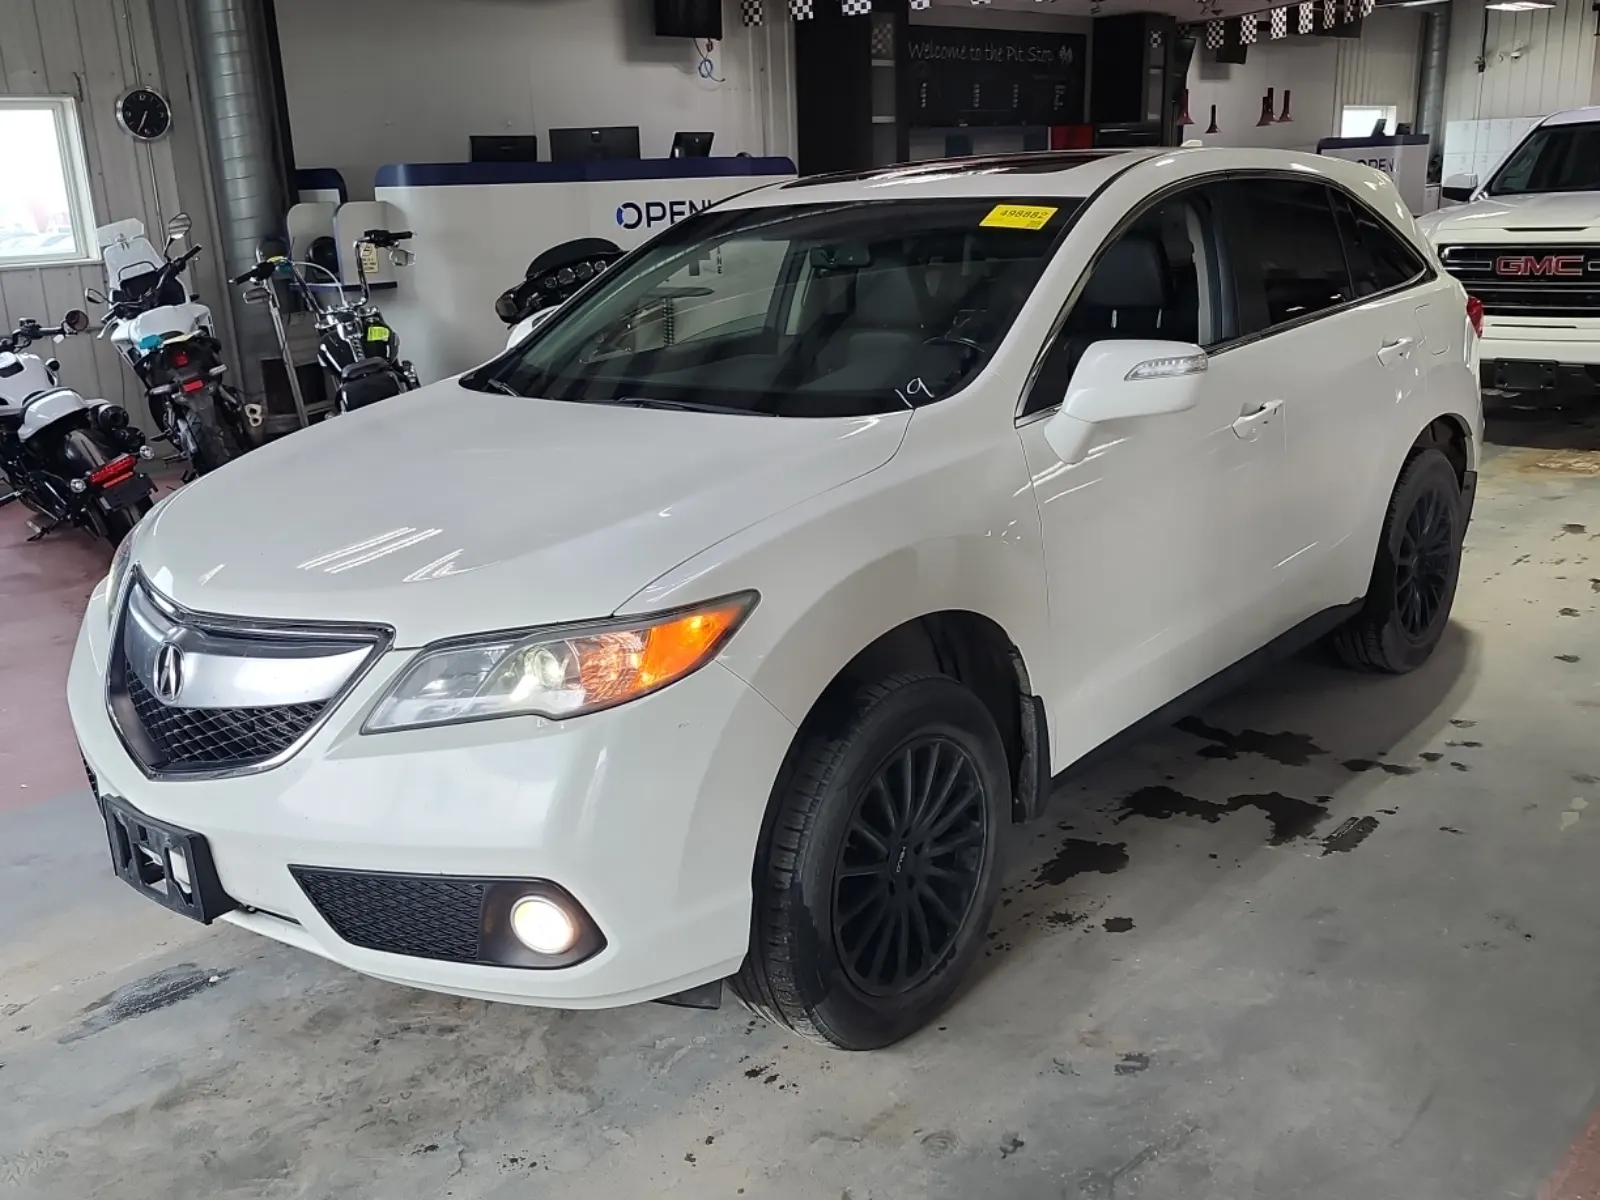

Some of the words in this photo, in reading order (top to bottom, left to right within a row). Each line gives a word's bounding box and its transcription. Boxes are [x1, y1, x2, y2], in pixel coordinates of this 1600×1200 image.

[908, 40, 967, 60] Welcome
[970, 45, 982, 61] to
[984, 43, 1003, 62] the
[1007, 46, 1024, 61] Pit
[1495, 255, 1584, 276] GMC
[894, 377, 934, 408] 19
